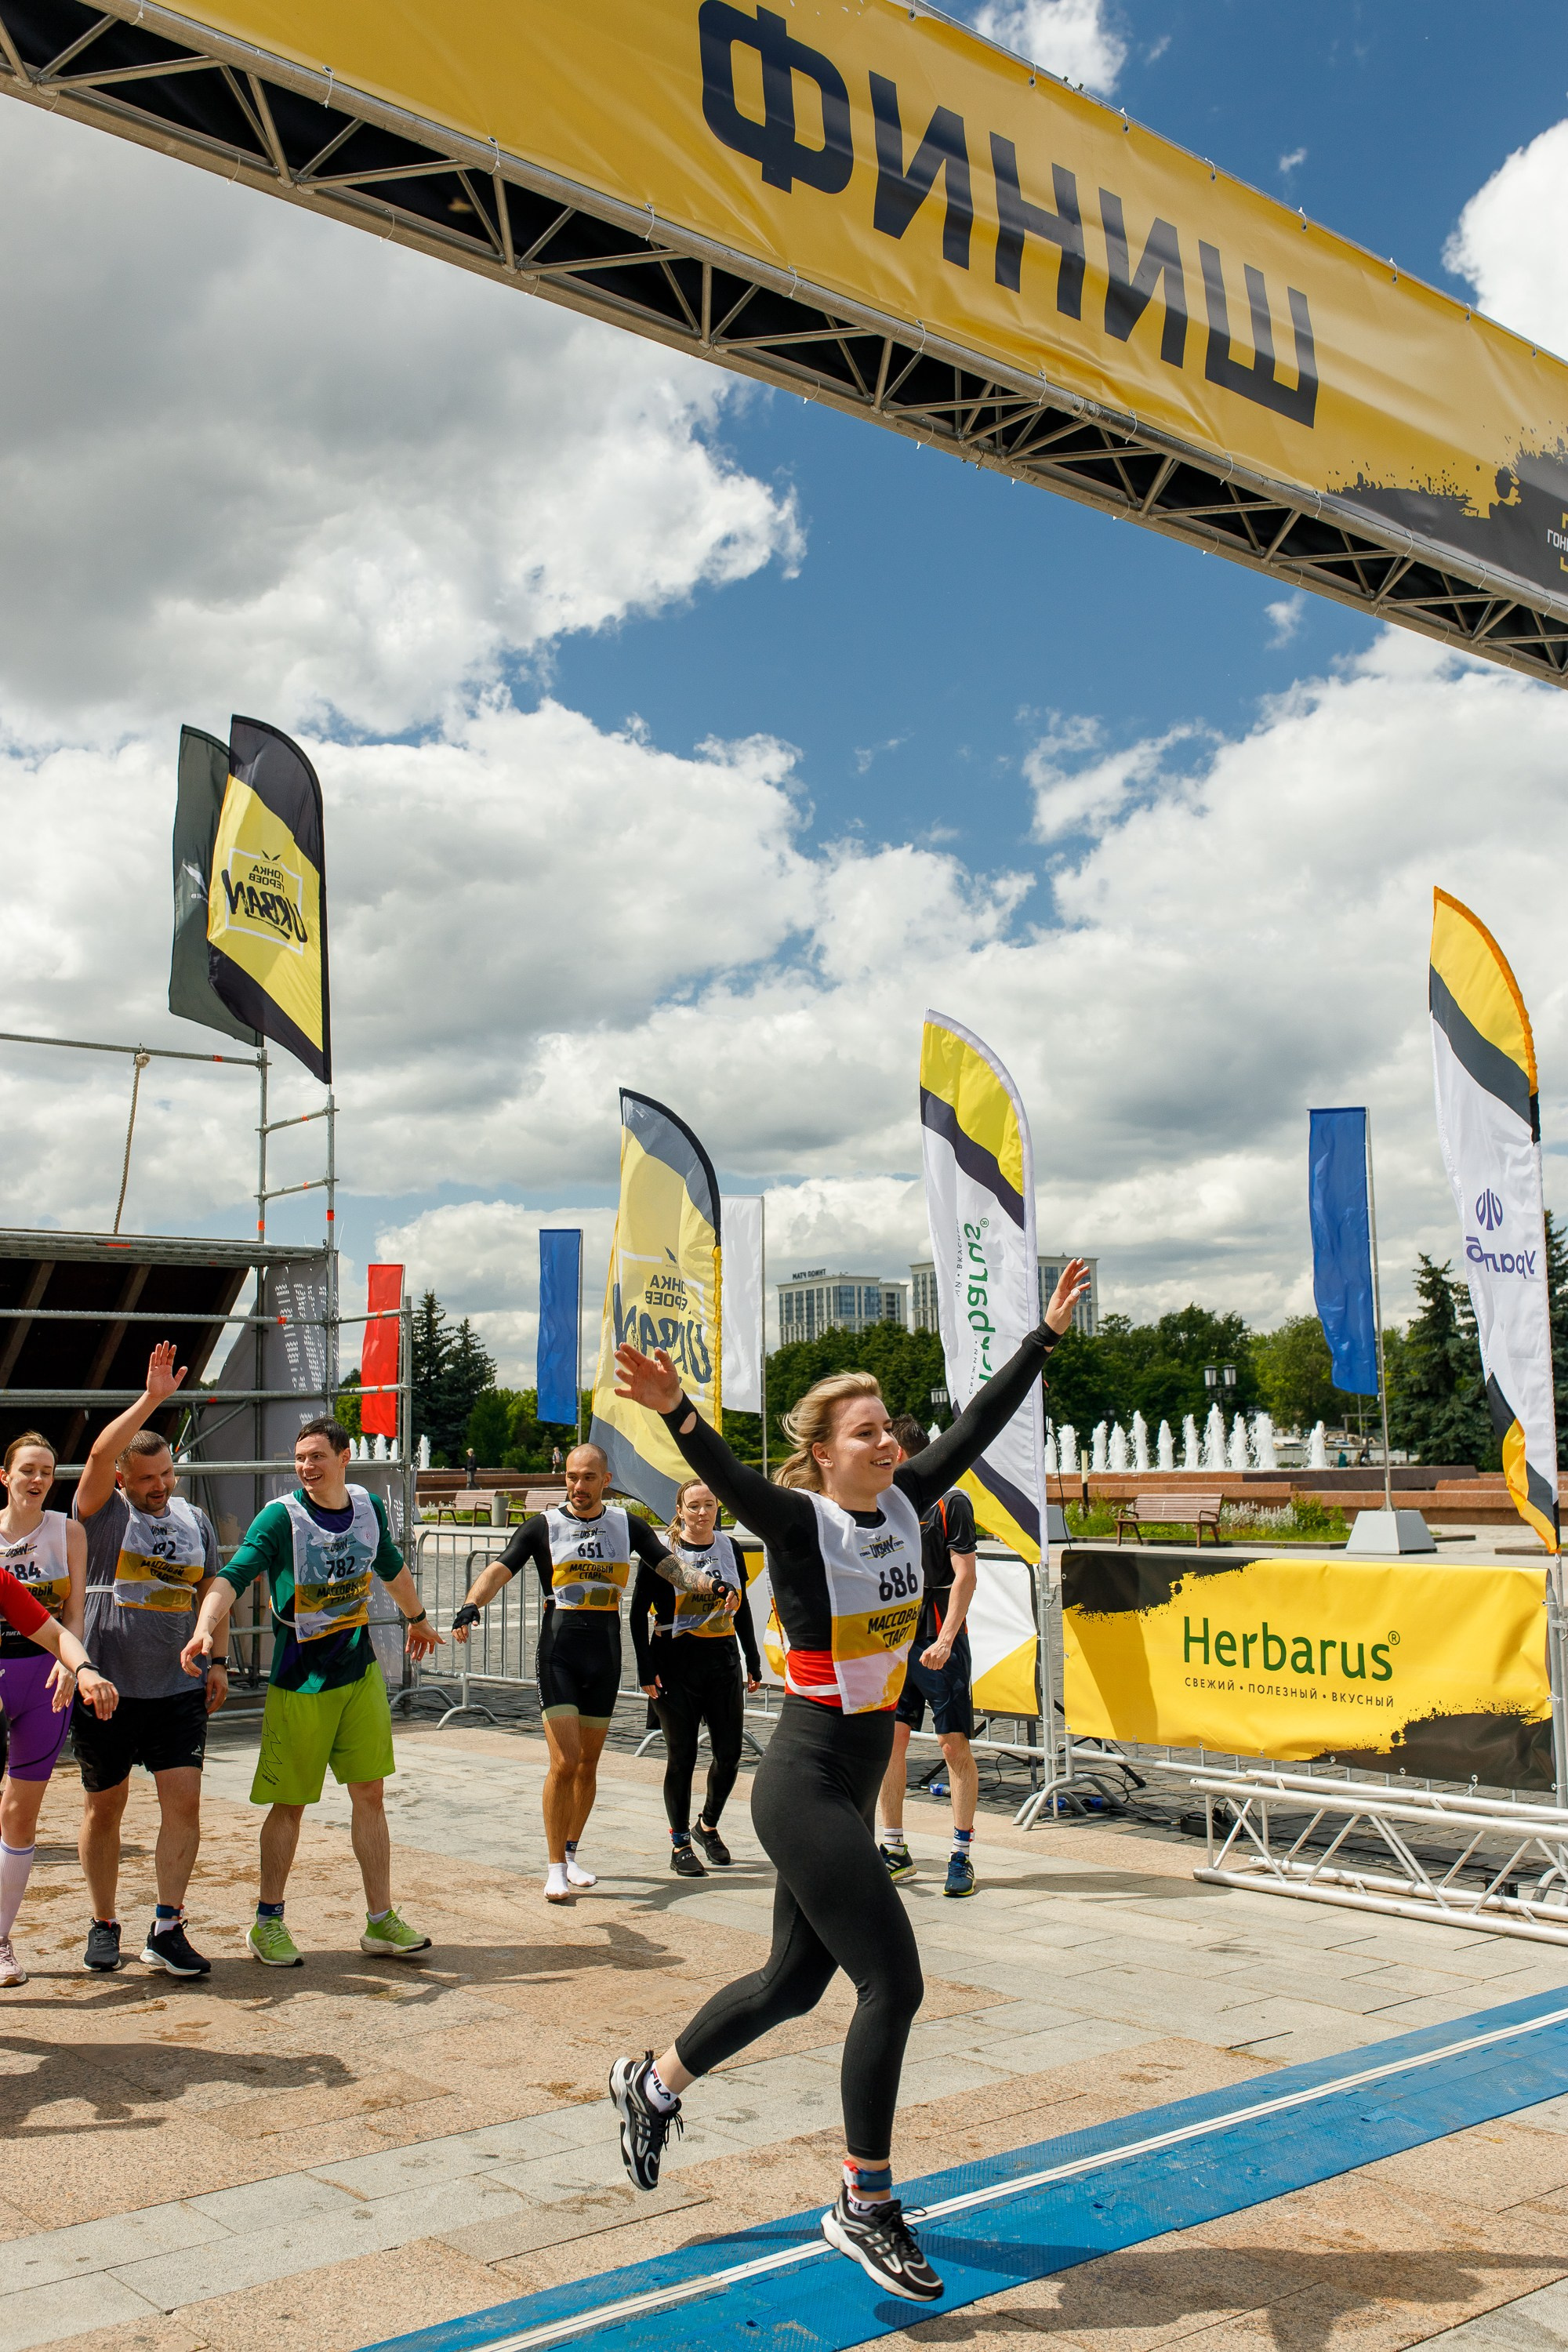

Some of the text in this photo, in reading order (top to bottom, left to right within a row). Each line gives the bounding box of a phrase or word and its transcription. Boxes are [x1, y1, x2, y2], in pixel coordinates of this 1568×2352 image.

[699, 1, 1319, 428] ФИНИШ
[577, 1541, 604, 1559] 651
[869, 1534, 895, 1559] URBAN
[326, 1555, 355, 1578] 782
[569, 1563, 613, 1574] МАССОВЫЙ
[579, 1571, 602, 1580] СТАРТ
[879, 1562, 918, 1602] 686
[883, 1624, 911, 1649] СТАРТ
[1185, 1677, 1394, 1708] СВЕЖИЙ ПОЛЕЗНЫЙ ВКУСНЫЙ
[650, 2068, 671, 2101] FILA
